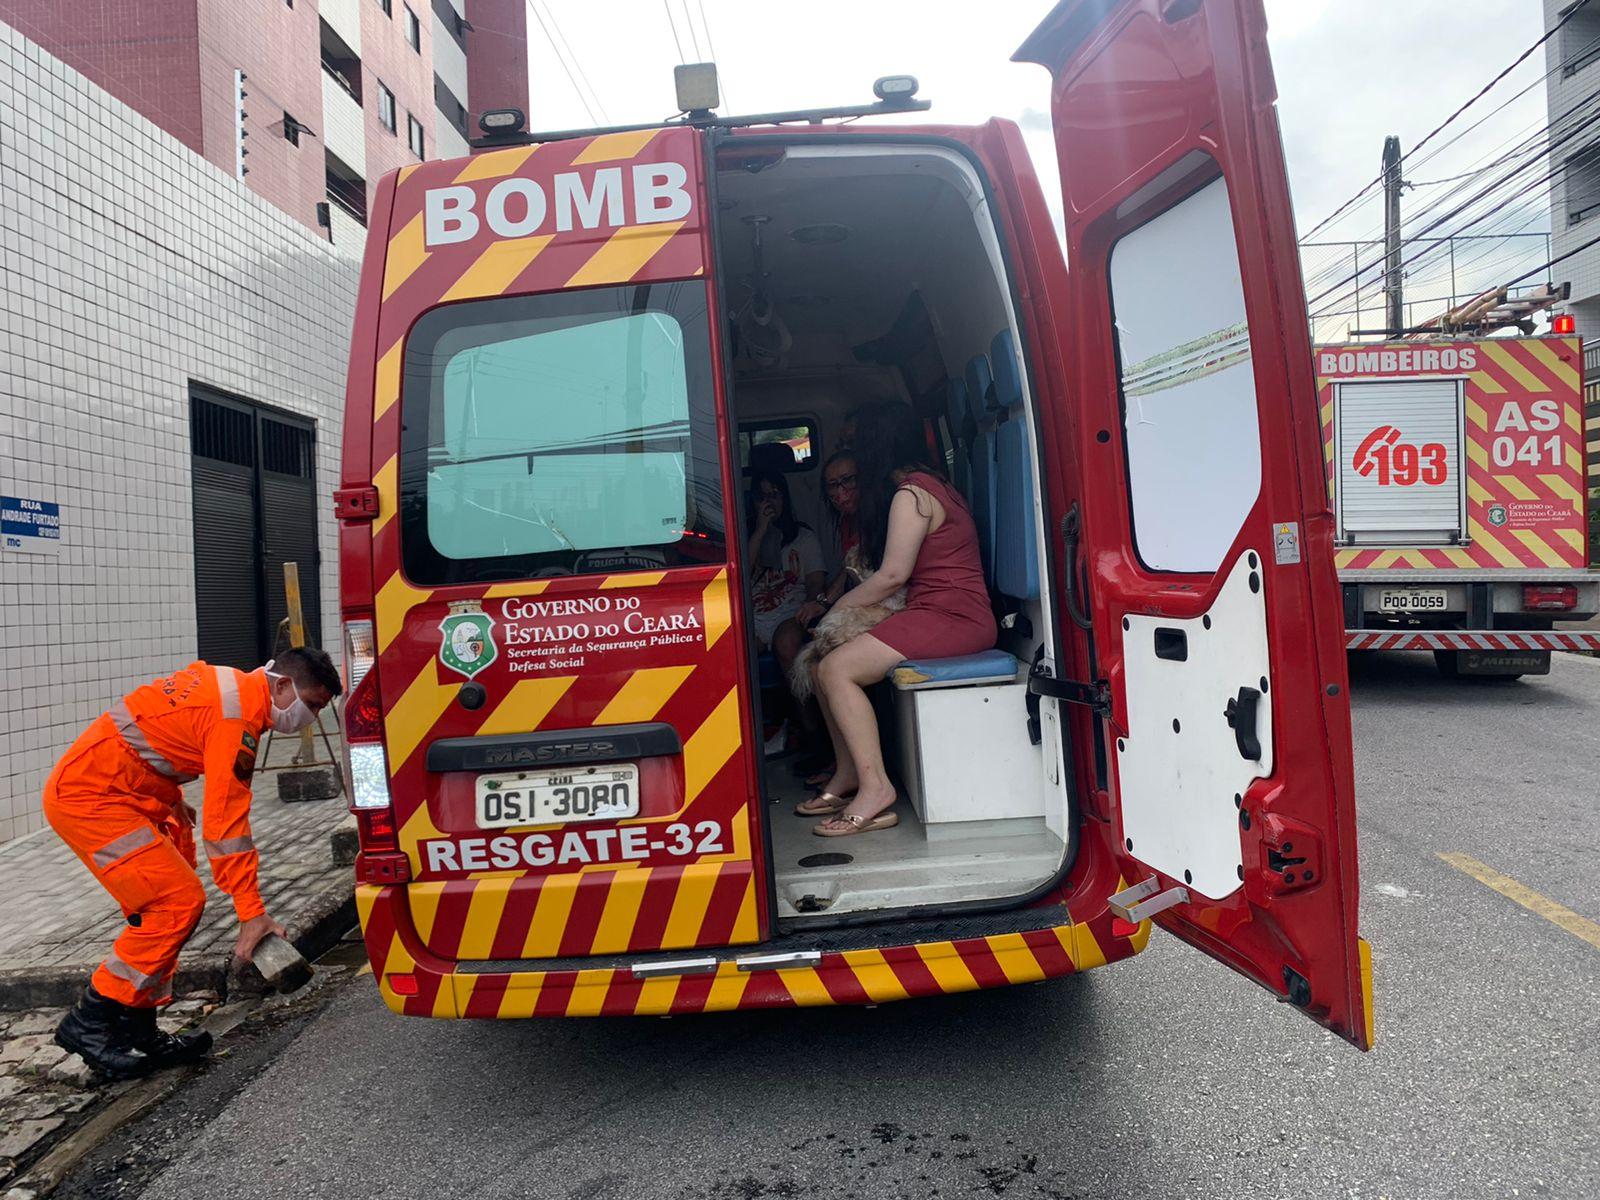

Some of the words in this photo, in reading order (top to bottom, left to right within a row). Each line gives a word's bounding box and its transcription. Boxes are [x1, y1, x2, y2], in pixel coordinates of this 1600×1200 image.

[425, 162, 692, 246] BOMB
[1321, 348, 1477, 374] BOMBEIROS
[1494, 400, 1561, 432] AS
[1371, 443, 1448, 486] 193
[1492, 435, 1561, 467] 041
[1, 509, 31, 523] ANDRADE
[32, 513, 59, 527] FURTADO
[20, 500, 42, 511] RUA
[502, 596, 610, 620] GOVERNO
[615, 597, 640, 611] DO
[503, 623, 589, 645] ESTADO
[594, 624, 619, 638] DO
[624, 607, 700, 635] CEARÁ
[508, 645, 565, 659] Secretaria
[569, 643, 583, 654] da
[586, 638, 646, 653] Segurança
[650, 631, 693, 647] Pública
[696, 634, 703, 642] e
[509, 660, 546, 673] Defesa
[549, 656, 585, 669] Social
[486, 741, 616, 764] MASTER
[426, 820, 723, 872] RESGATE-32
